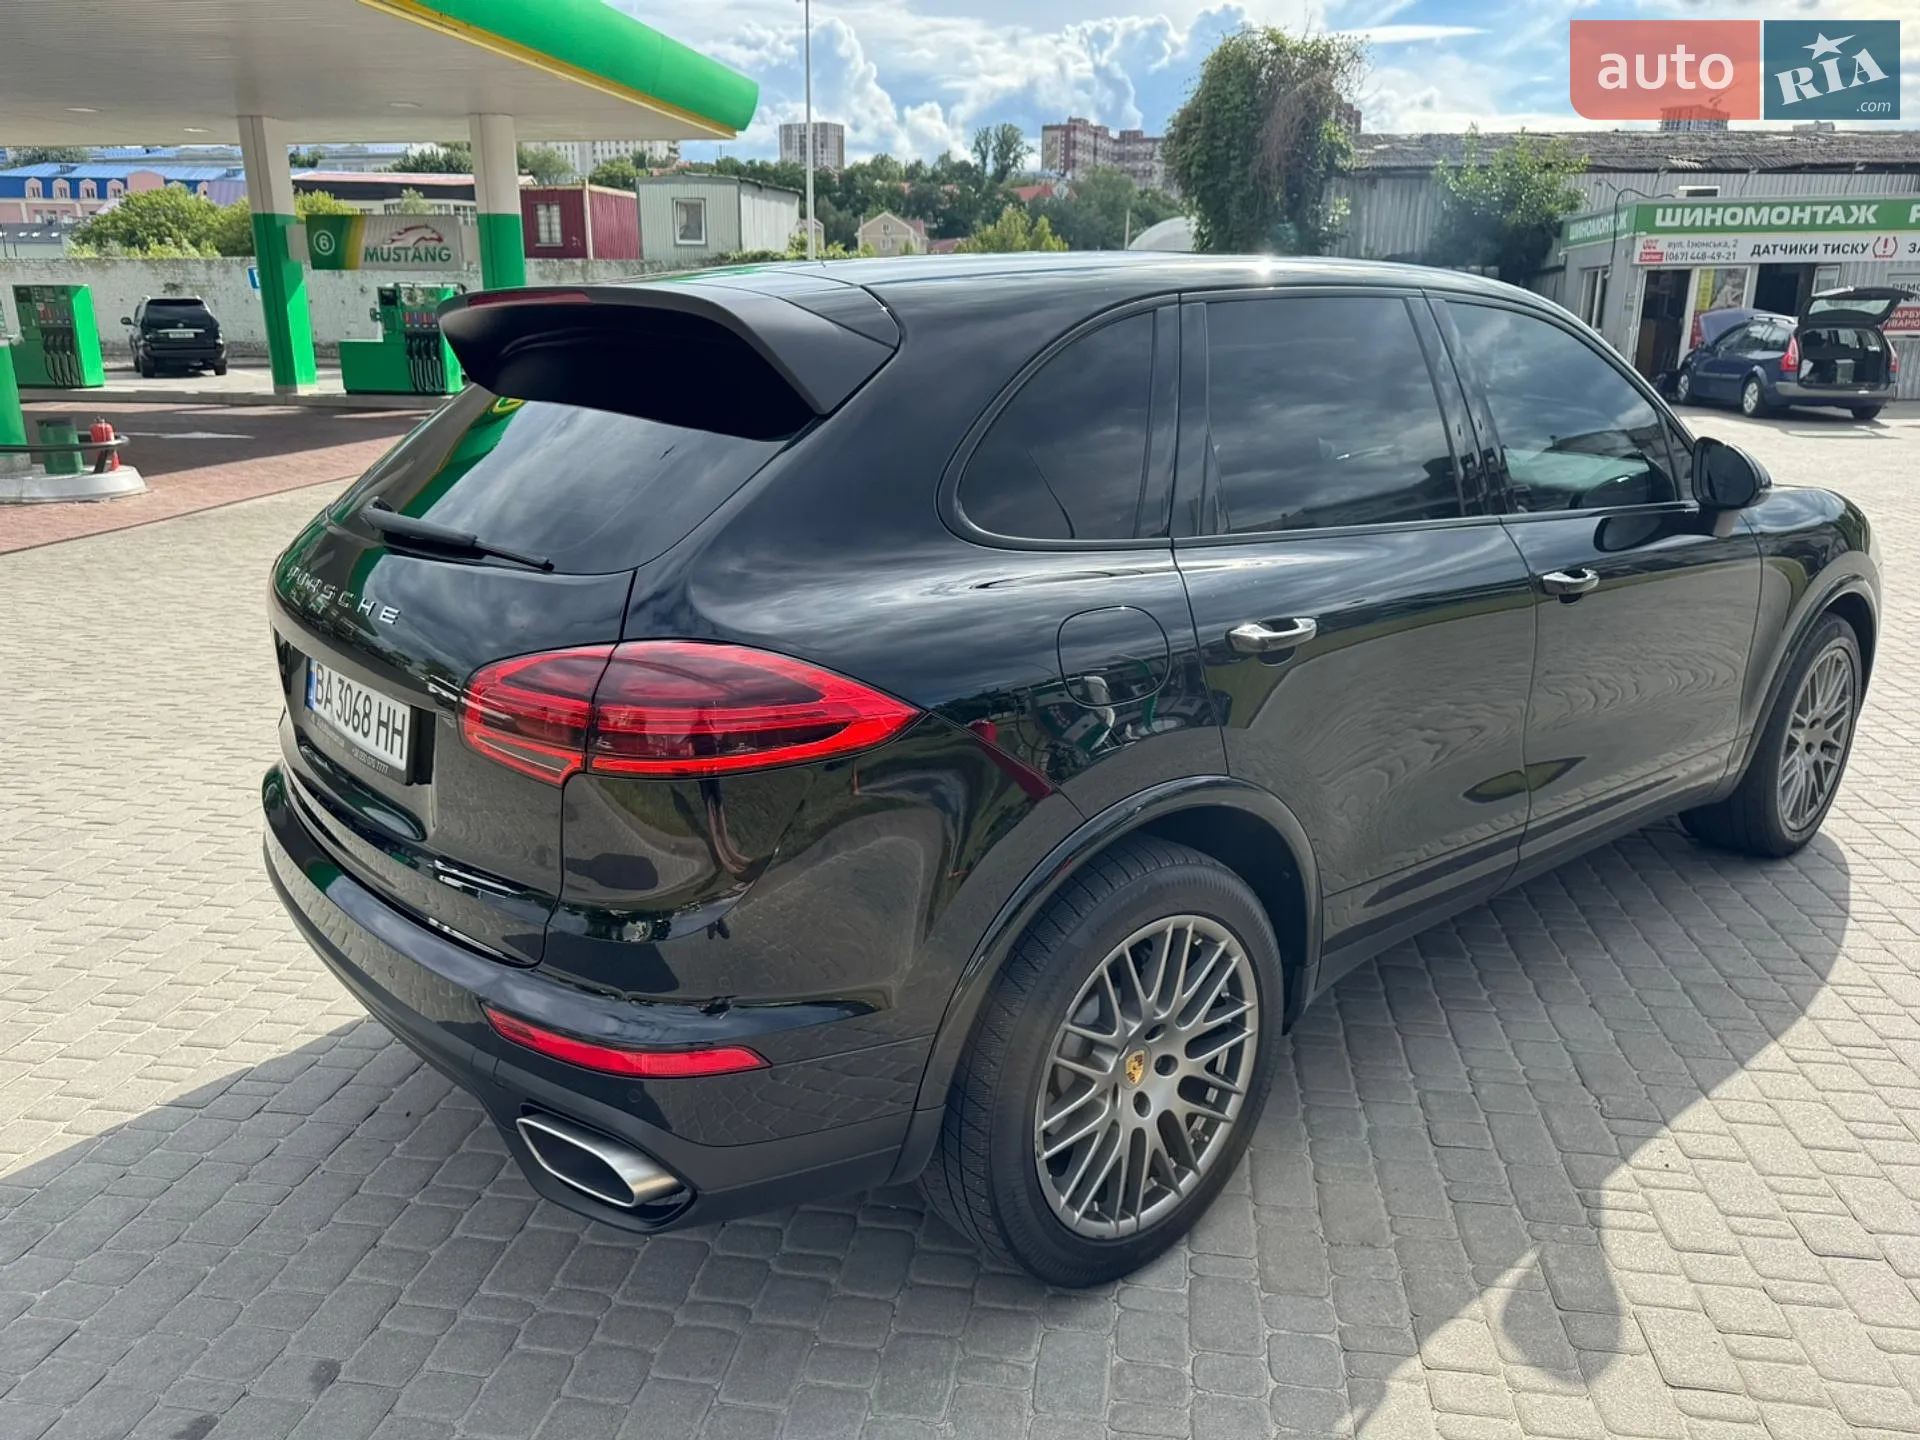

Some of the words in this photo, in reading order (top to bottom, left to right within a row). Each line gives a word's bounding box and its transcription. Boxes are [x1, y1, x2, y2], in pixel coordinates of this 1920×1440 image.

[1654, 204, 1880, 228] ШИНОМОНТАЖ
[319, 236, 330, 250] 6
[1750, 243, 1819, 257] ДАТЧИКИ
[1823, 243, 1869, 254] ТИСКУ
[363, 247, 451, 263] MUSTANG
[1690, 251, 1737, 261] 448-49-21
[286, 566, 401, 625] PORSCHE
[315, 664, 333, 714] BA
[336, 678, 373, 738] 3068
[376, 701, 406, 760] HH
